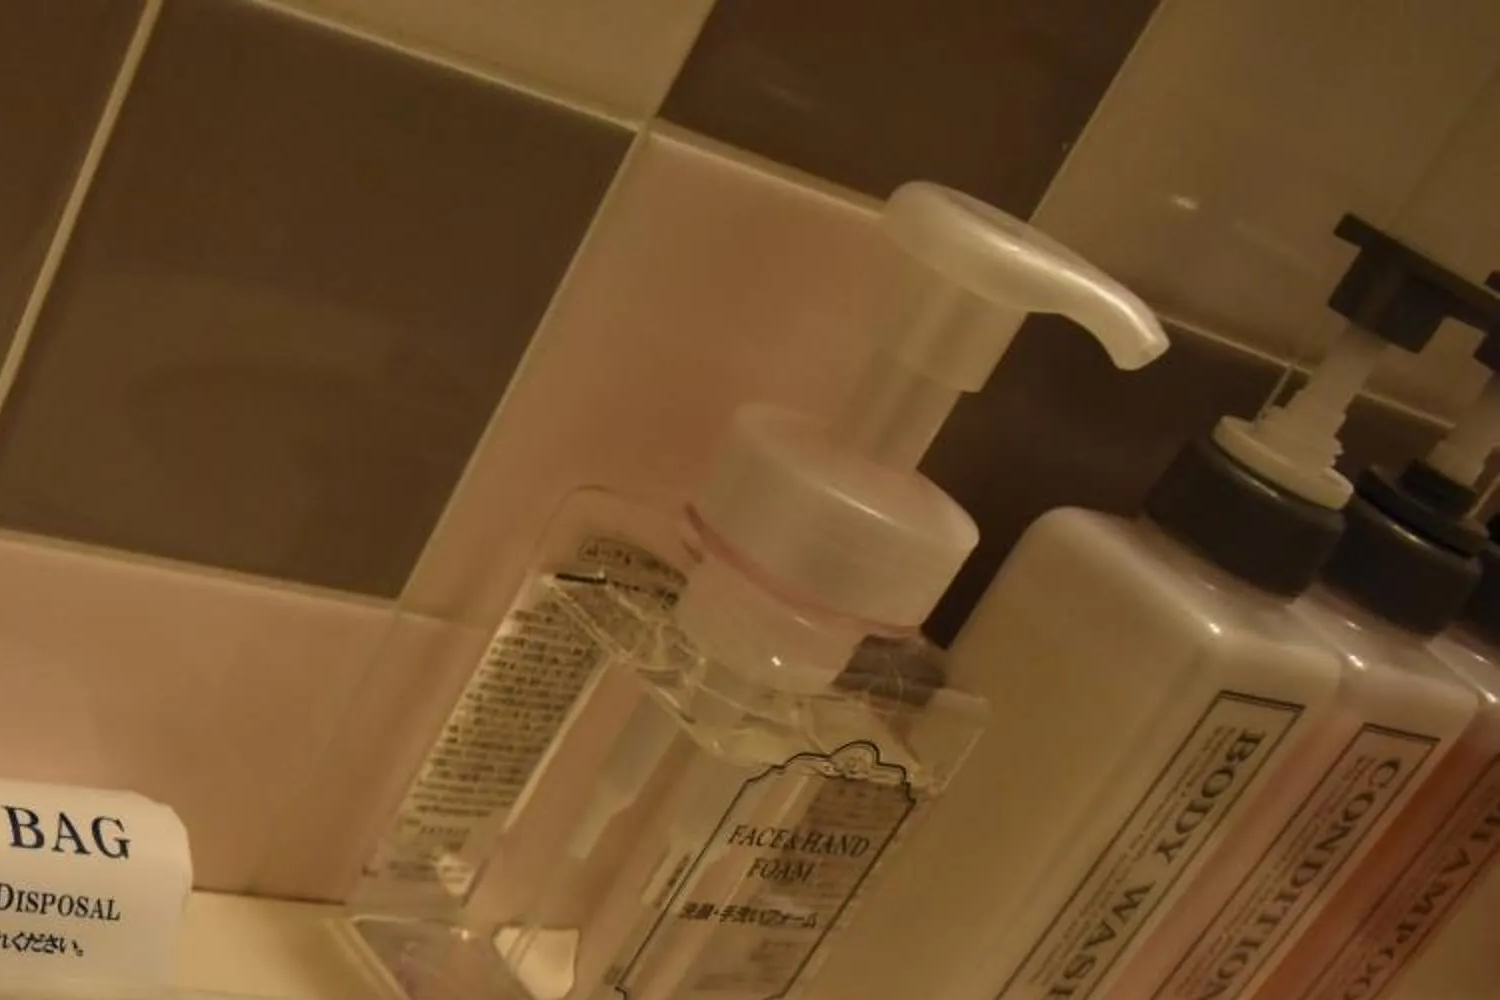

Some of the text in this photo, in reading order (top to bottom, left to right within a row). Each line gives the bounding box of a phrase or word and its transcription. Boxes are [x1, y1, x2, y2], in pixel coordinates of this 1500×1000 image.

[1155, 729, 1266, 864] BODY
[1, 804, 132, 860] BAG
[747, 857, 815, 882] FOAM
